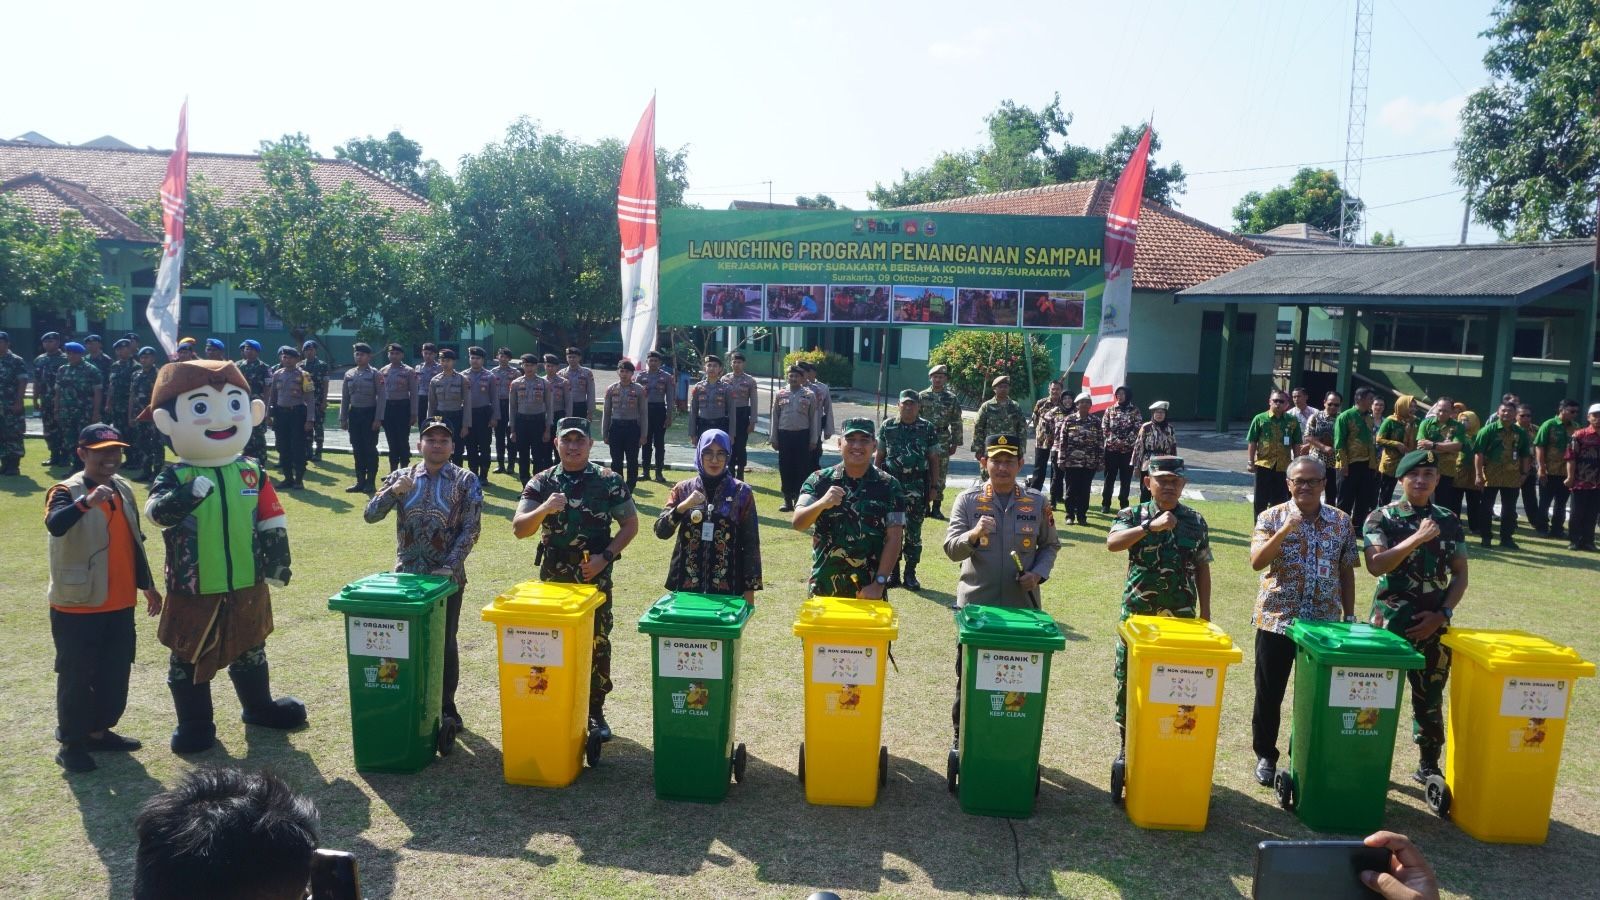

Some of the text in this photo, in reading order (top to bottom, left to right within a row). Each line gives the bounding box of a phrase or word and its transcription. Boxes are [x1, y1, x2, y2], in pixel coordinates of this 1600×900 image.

[689, 241, 1102, 266] LAUNCHING PROGRAM PENANGANAN SAMPAH
[718, 261, 1071, 278] KERJASAMA PEMKOT SURAKARTA BERSAMA KODIM 0735/SURAKARTA
[832, 273, 954, 284] Surakarta, 09 Oktober 2025
[363, 622, 395, 630] ORGANIK
[673, 642, 708, 650] ORGANIK
[993, 654, 1028, 663] ORGANIK
